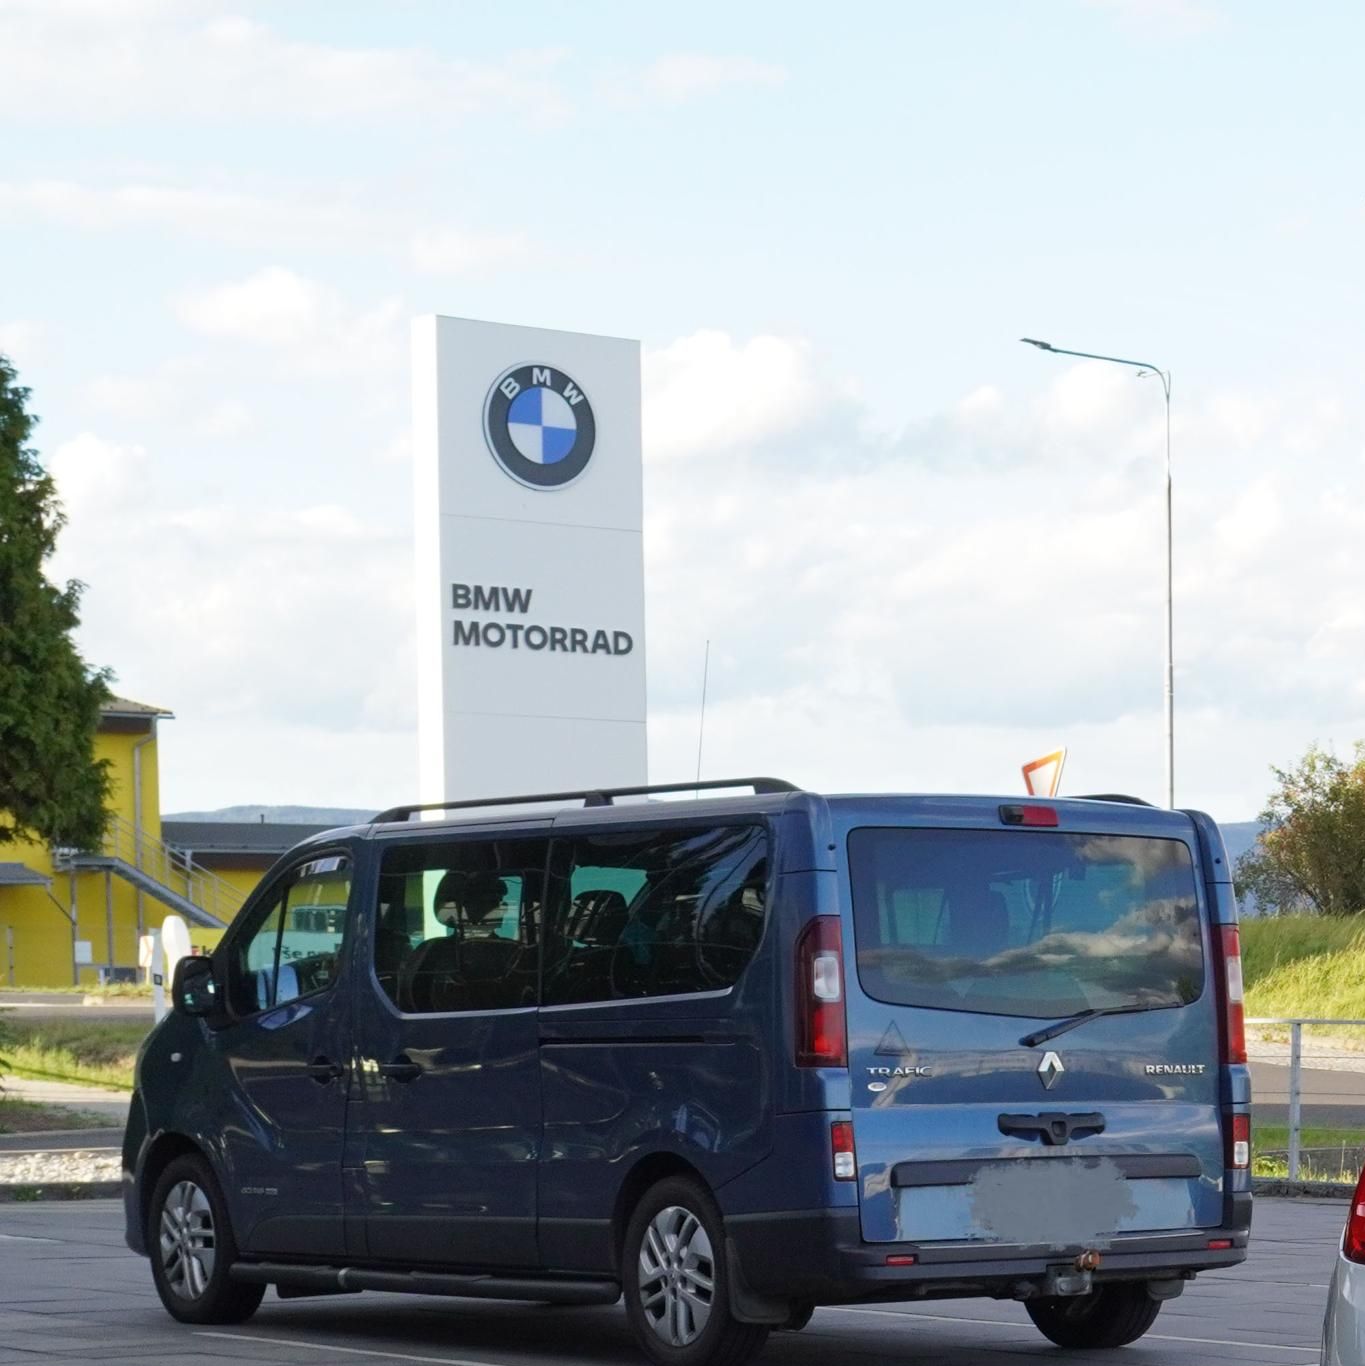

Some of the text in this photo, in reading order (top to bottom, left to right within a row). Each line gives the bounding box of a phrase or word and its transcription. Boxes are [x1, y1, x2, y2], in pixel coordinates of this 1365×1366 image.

[499, 367, 585, 407] BMW
[452, 583, 533, 613] BMW
[453, 620, 634, 656] MOTORRAD
[866, 1066, 933, 1078] TRAFIC
[1145, 1064, 1206, 1075] RENAULT
